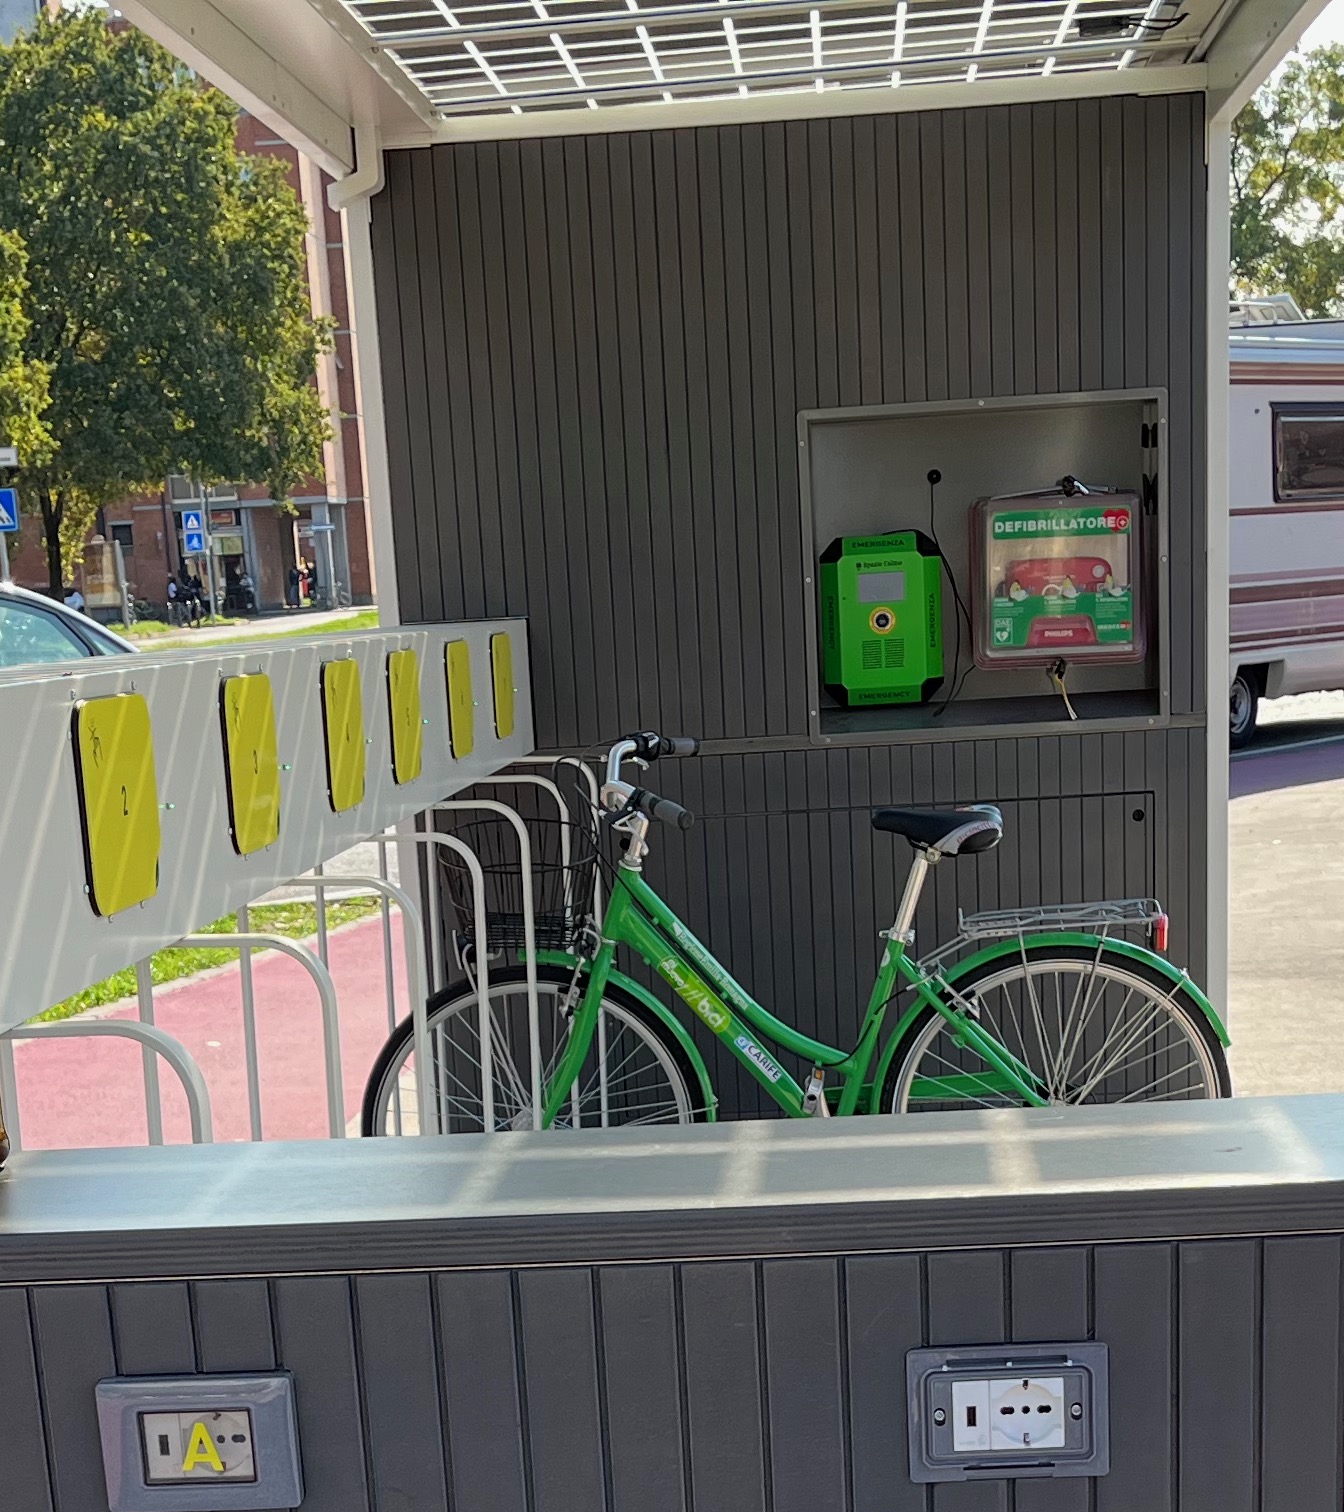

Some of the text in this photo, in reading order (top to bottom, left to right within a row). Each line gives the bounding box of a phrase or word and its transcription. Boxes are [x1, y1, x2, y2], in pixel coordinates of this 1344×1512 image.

[994, 516, 1116, 533] DEFIBRILLATORE
[851, 540, 905, 549] EMERGENZA
[928, 592, 936, 648] EMERGENZA
[859, 691, 911, 700] EMERGENCY
[121, 785, 128, 816] 2
[745, 1043, 782, 1080] CARIFE
[182, 1422, 225, 1472] A
